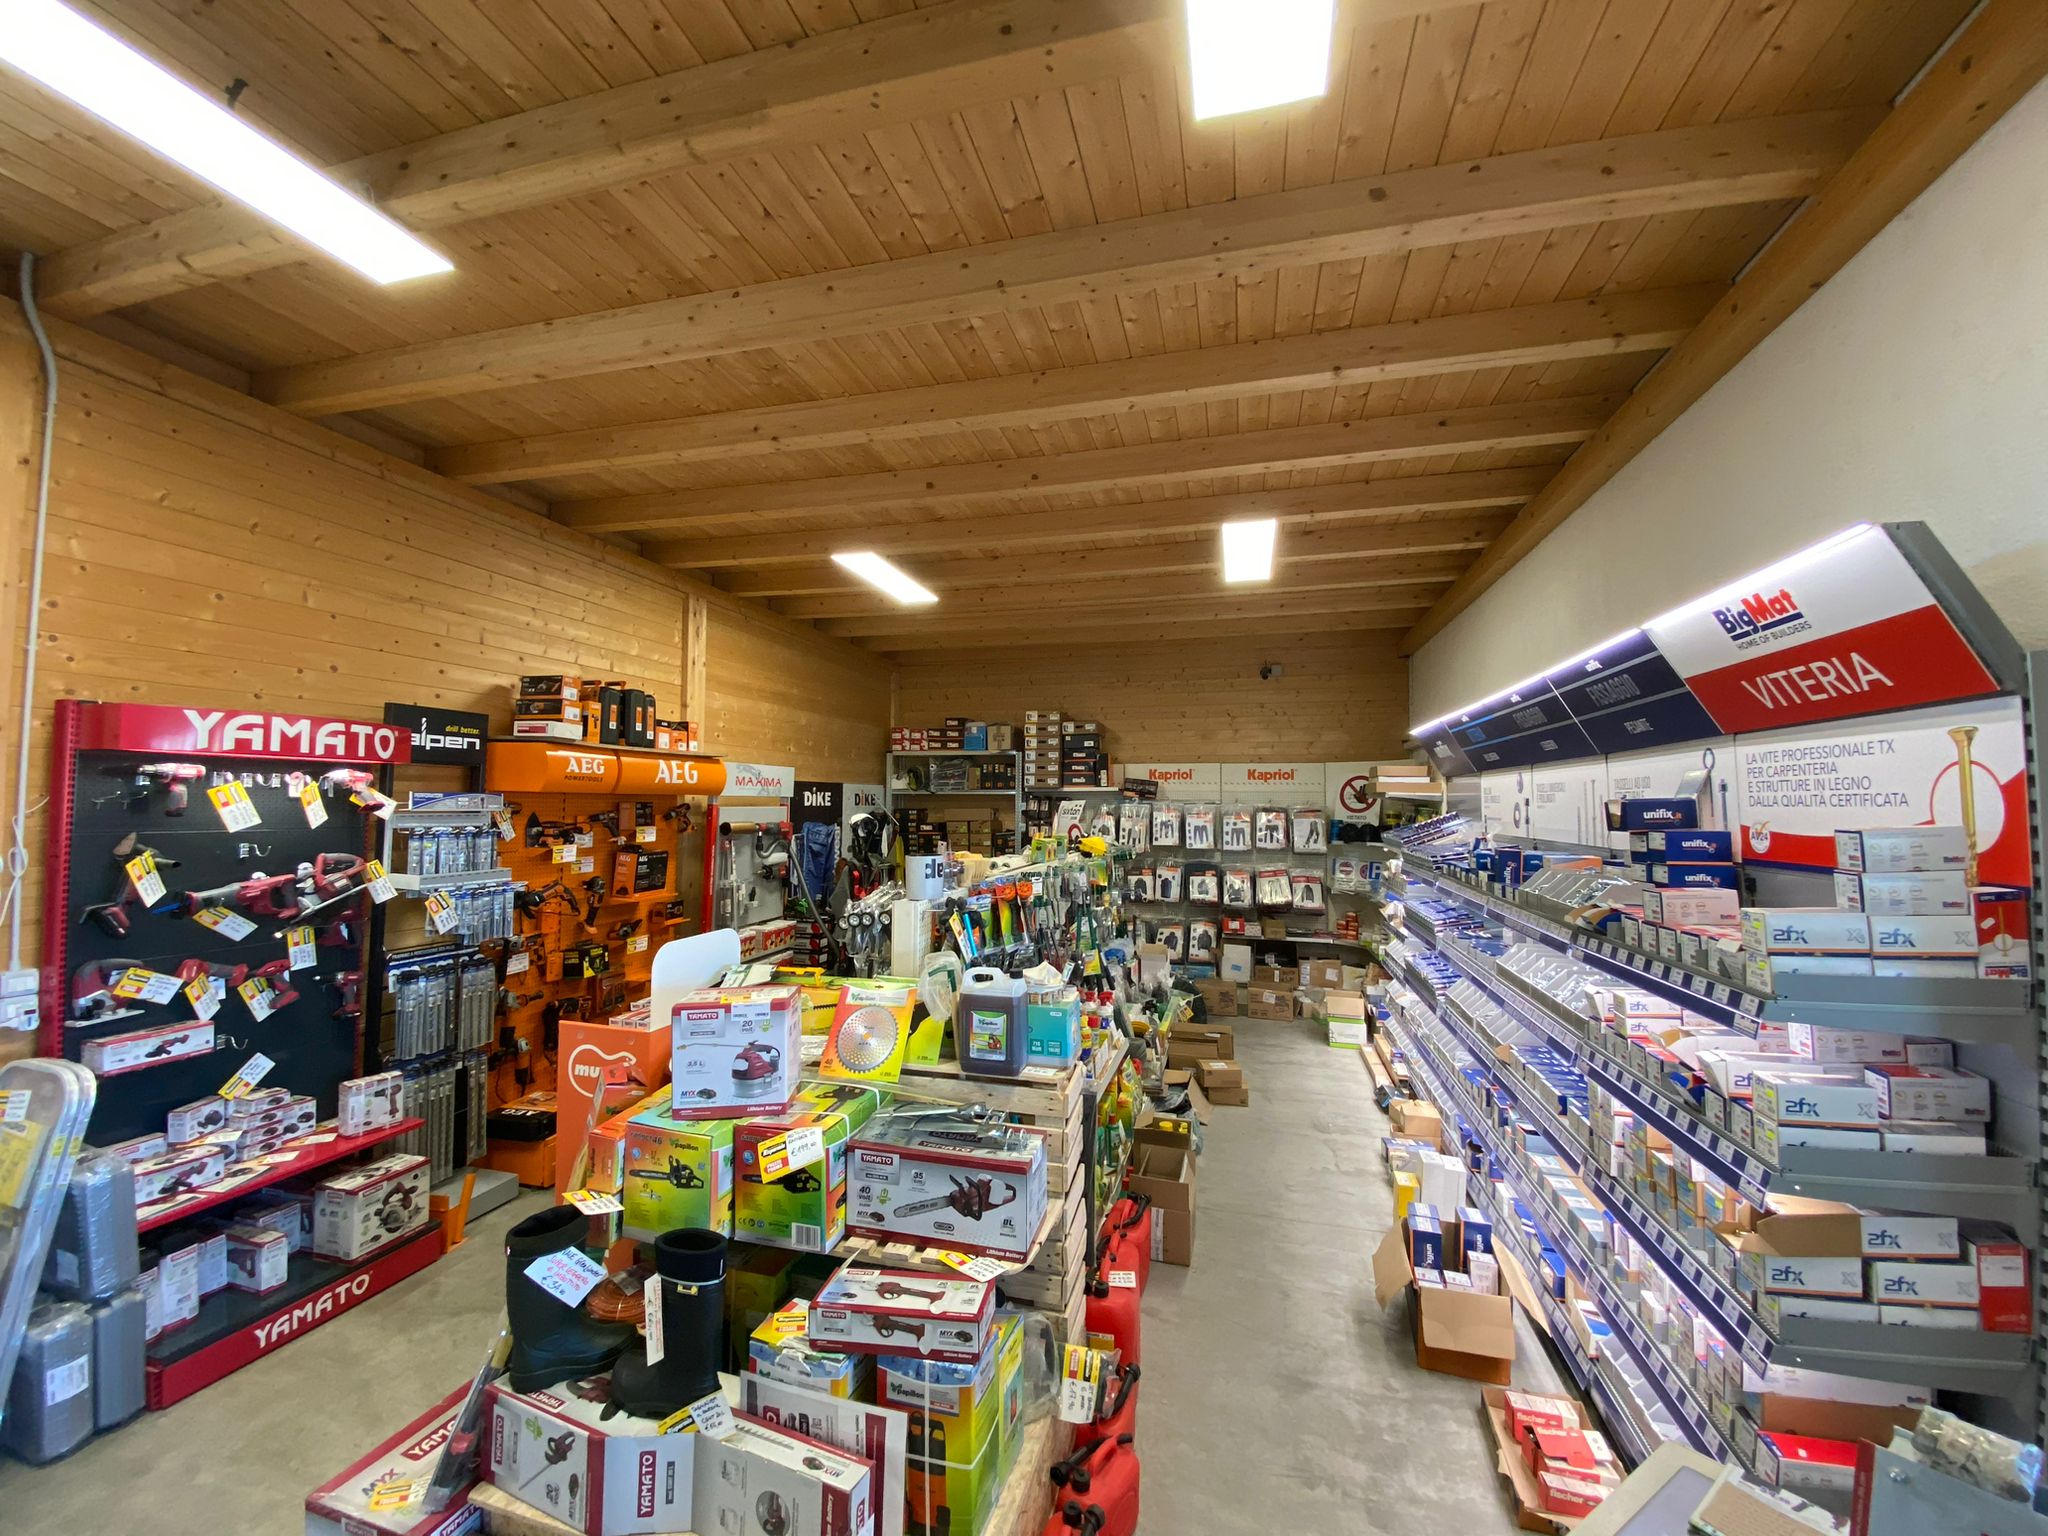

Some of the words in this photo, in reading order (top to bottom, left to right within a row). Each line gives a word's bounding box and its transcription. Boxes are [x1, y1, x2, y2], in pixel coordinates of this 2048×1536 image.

[1712, 589, 1798, 634] BigMat
[1735, 638, 1760, 651] HOME
[1759, 635, 1772, 644] OF
[1771, 621, 1812, 640] BUILDERS
[1741, 652, 1894, 710] VITERIA
[183, 709, 395, 759] YAMATO
[445, 725, 459, 734] drill
[1746, 753, 1757, 765] LA
[1759, 750, 1779, 764] VITE
[1782, 741, 1875, 761] PROFESSIONALE
[1878, 739, 1895, 754] TX
[566, 757, 605, 774] AEG
[655, 760, 698, 784] AEG
[1747, 766, 1763, 779] PER
[1766, 762, 1838, 778] CARPENTERIA
[735, 776, 782, 787] MAXIMA
[1149, 769, 1193, 781] Kapriol
[1247, 768, 1294, 782] Kapriol
[1748, 781, 1753, 793] E
[1756, 779, 1810, 793] STRUTTURE
[1814, 778, 1825, 791] IN
[1829, 776, 1871, 791] LEGNO
[1750, 795, 1779, 808] DALLA
[1781, 791, 1826, 808] QUALITÀ
[1829, 792, 1909, 808] CERTIFICATA
[1734, 1072, 1752, 1087] 2f
[675, 1143, 699, 1151] papillon
[862, 1154, 892, 1164] YAMATO
[860, 1186, 870, 1194] 40
[986, 1248, 1005, 1257] Lithium
[1005, 1250, 1024, 1260] Battery
[254, 1273, 370, 1349] YAMATO
[823, 1311, 846, 1319] YAMATO
[529, 1391, 563, 1409] YAMAT
[898, 1386, 924, 1399] papillon
[1517, 1412, 1546, 1424] fischer
[495, 1418, 504, 1463] YAMATO
[640, 1454, 653, 1515] YAMATO
[1550, 1489, 1584, 1504] fischer
